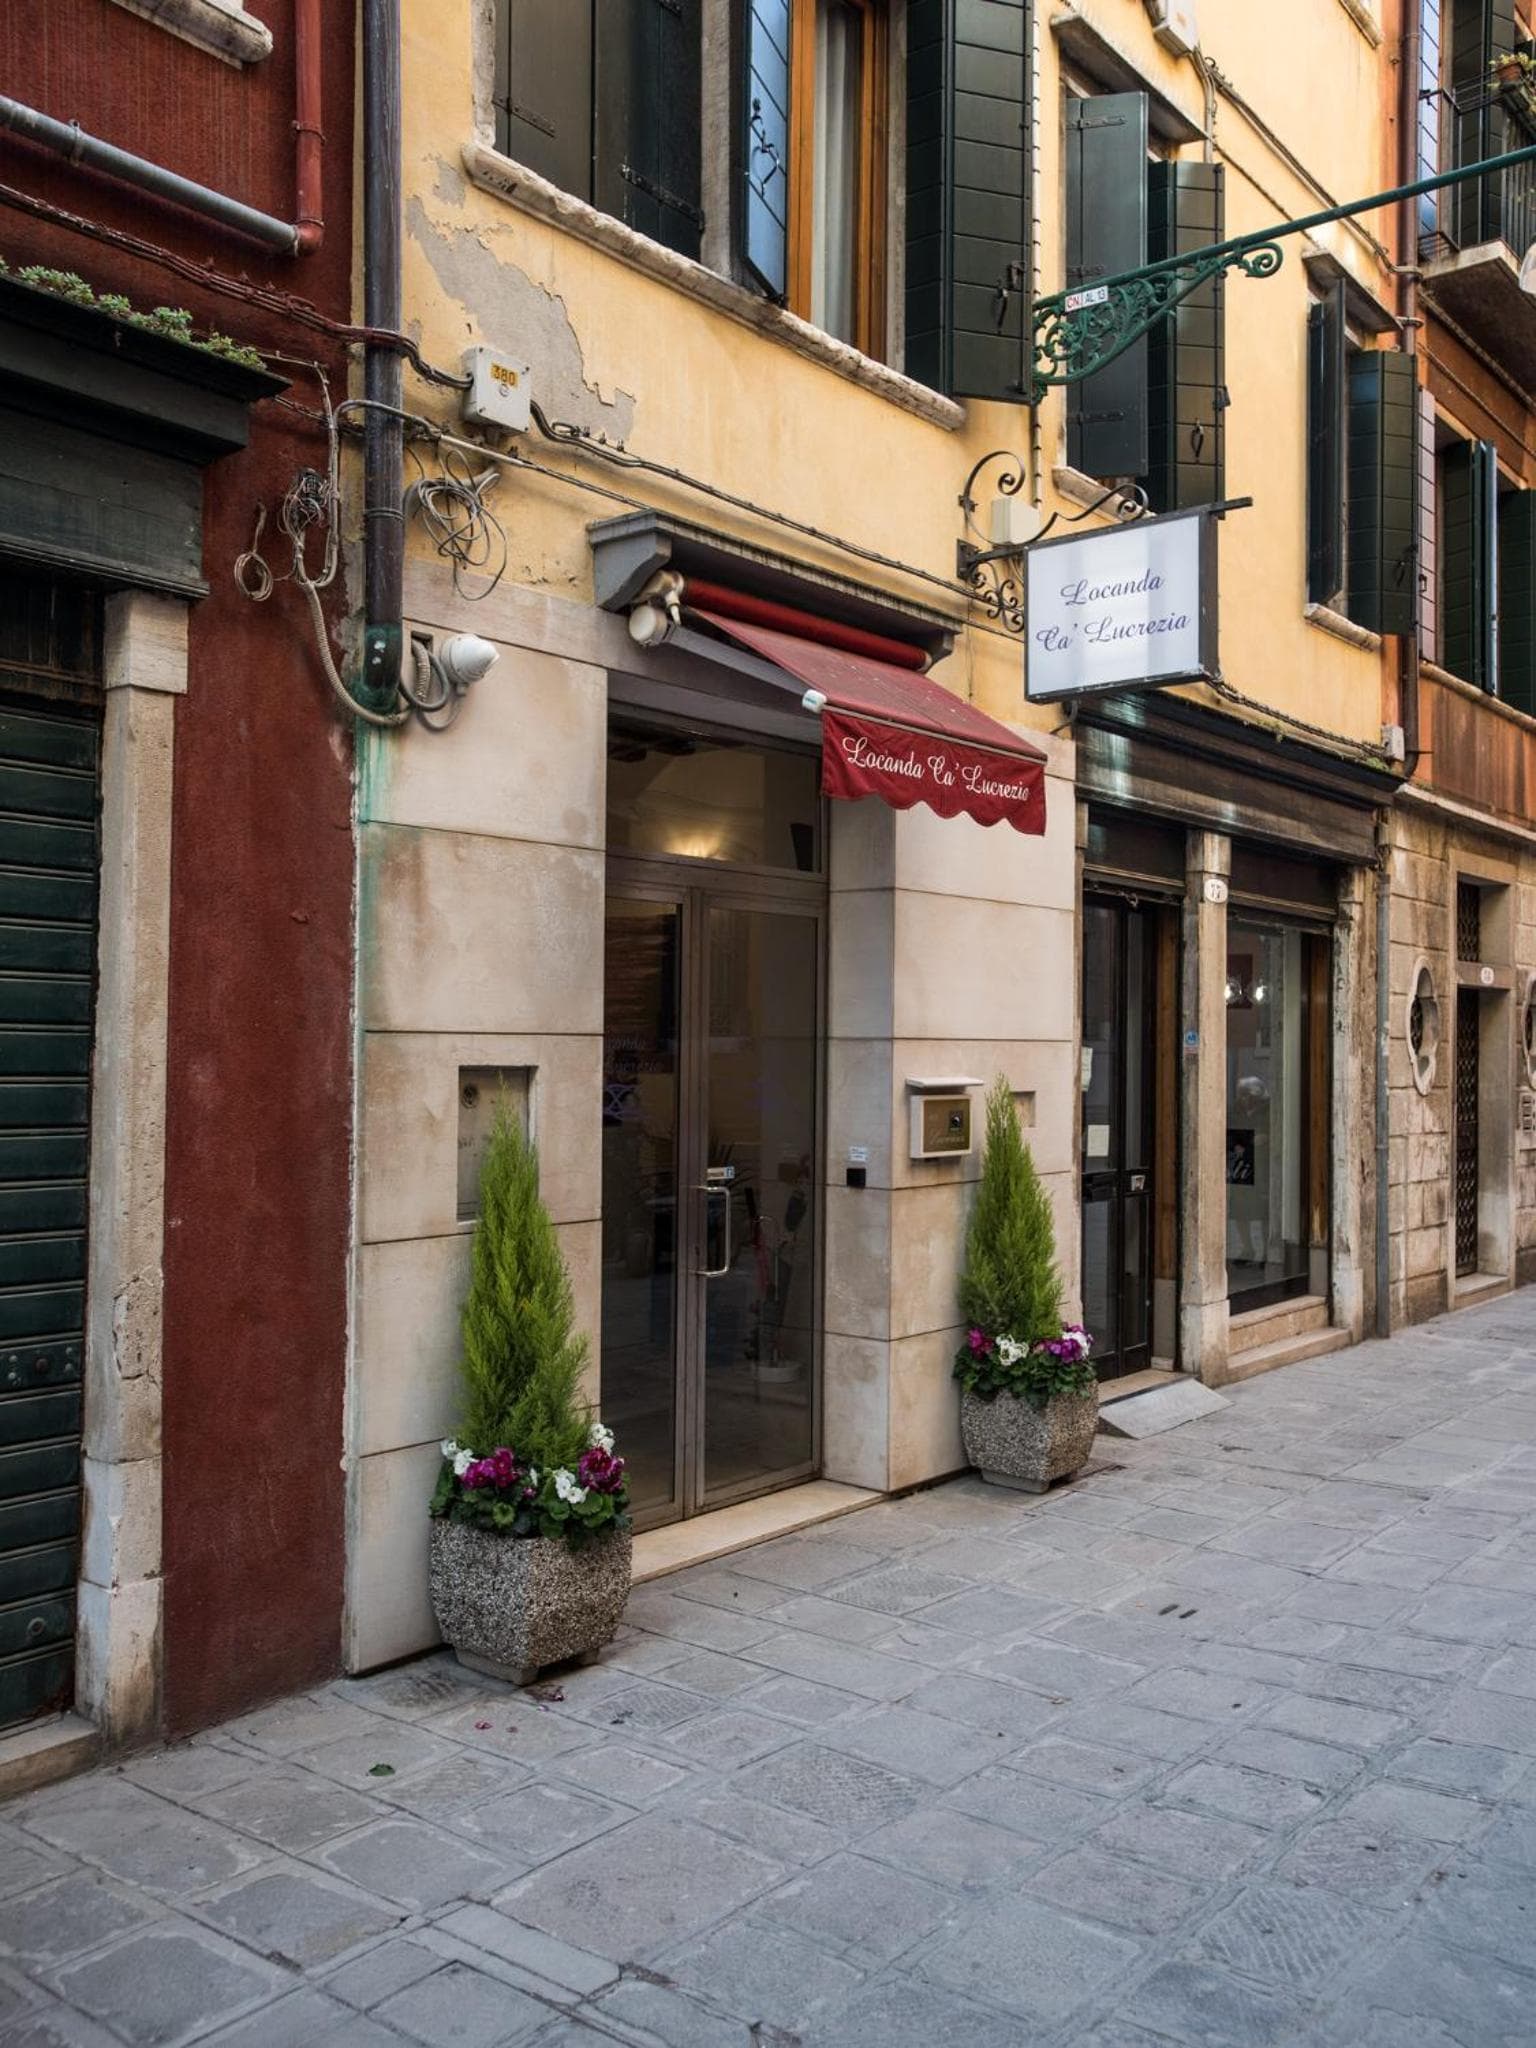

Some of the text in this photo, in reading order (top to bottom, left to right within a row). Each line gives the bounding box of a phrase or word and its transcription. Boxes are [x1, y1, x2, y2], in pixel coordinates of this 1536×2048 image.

[492, 364, 516, 386] 380
[1060, 567, 1165, 606] Locanda
[1035, 612, 1191, 652] Ca' Lucrezia
[842, 736, 926, 779] Locanda
[927, 755, 960, 786] Ca'
